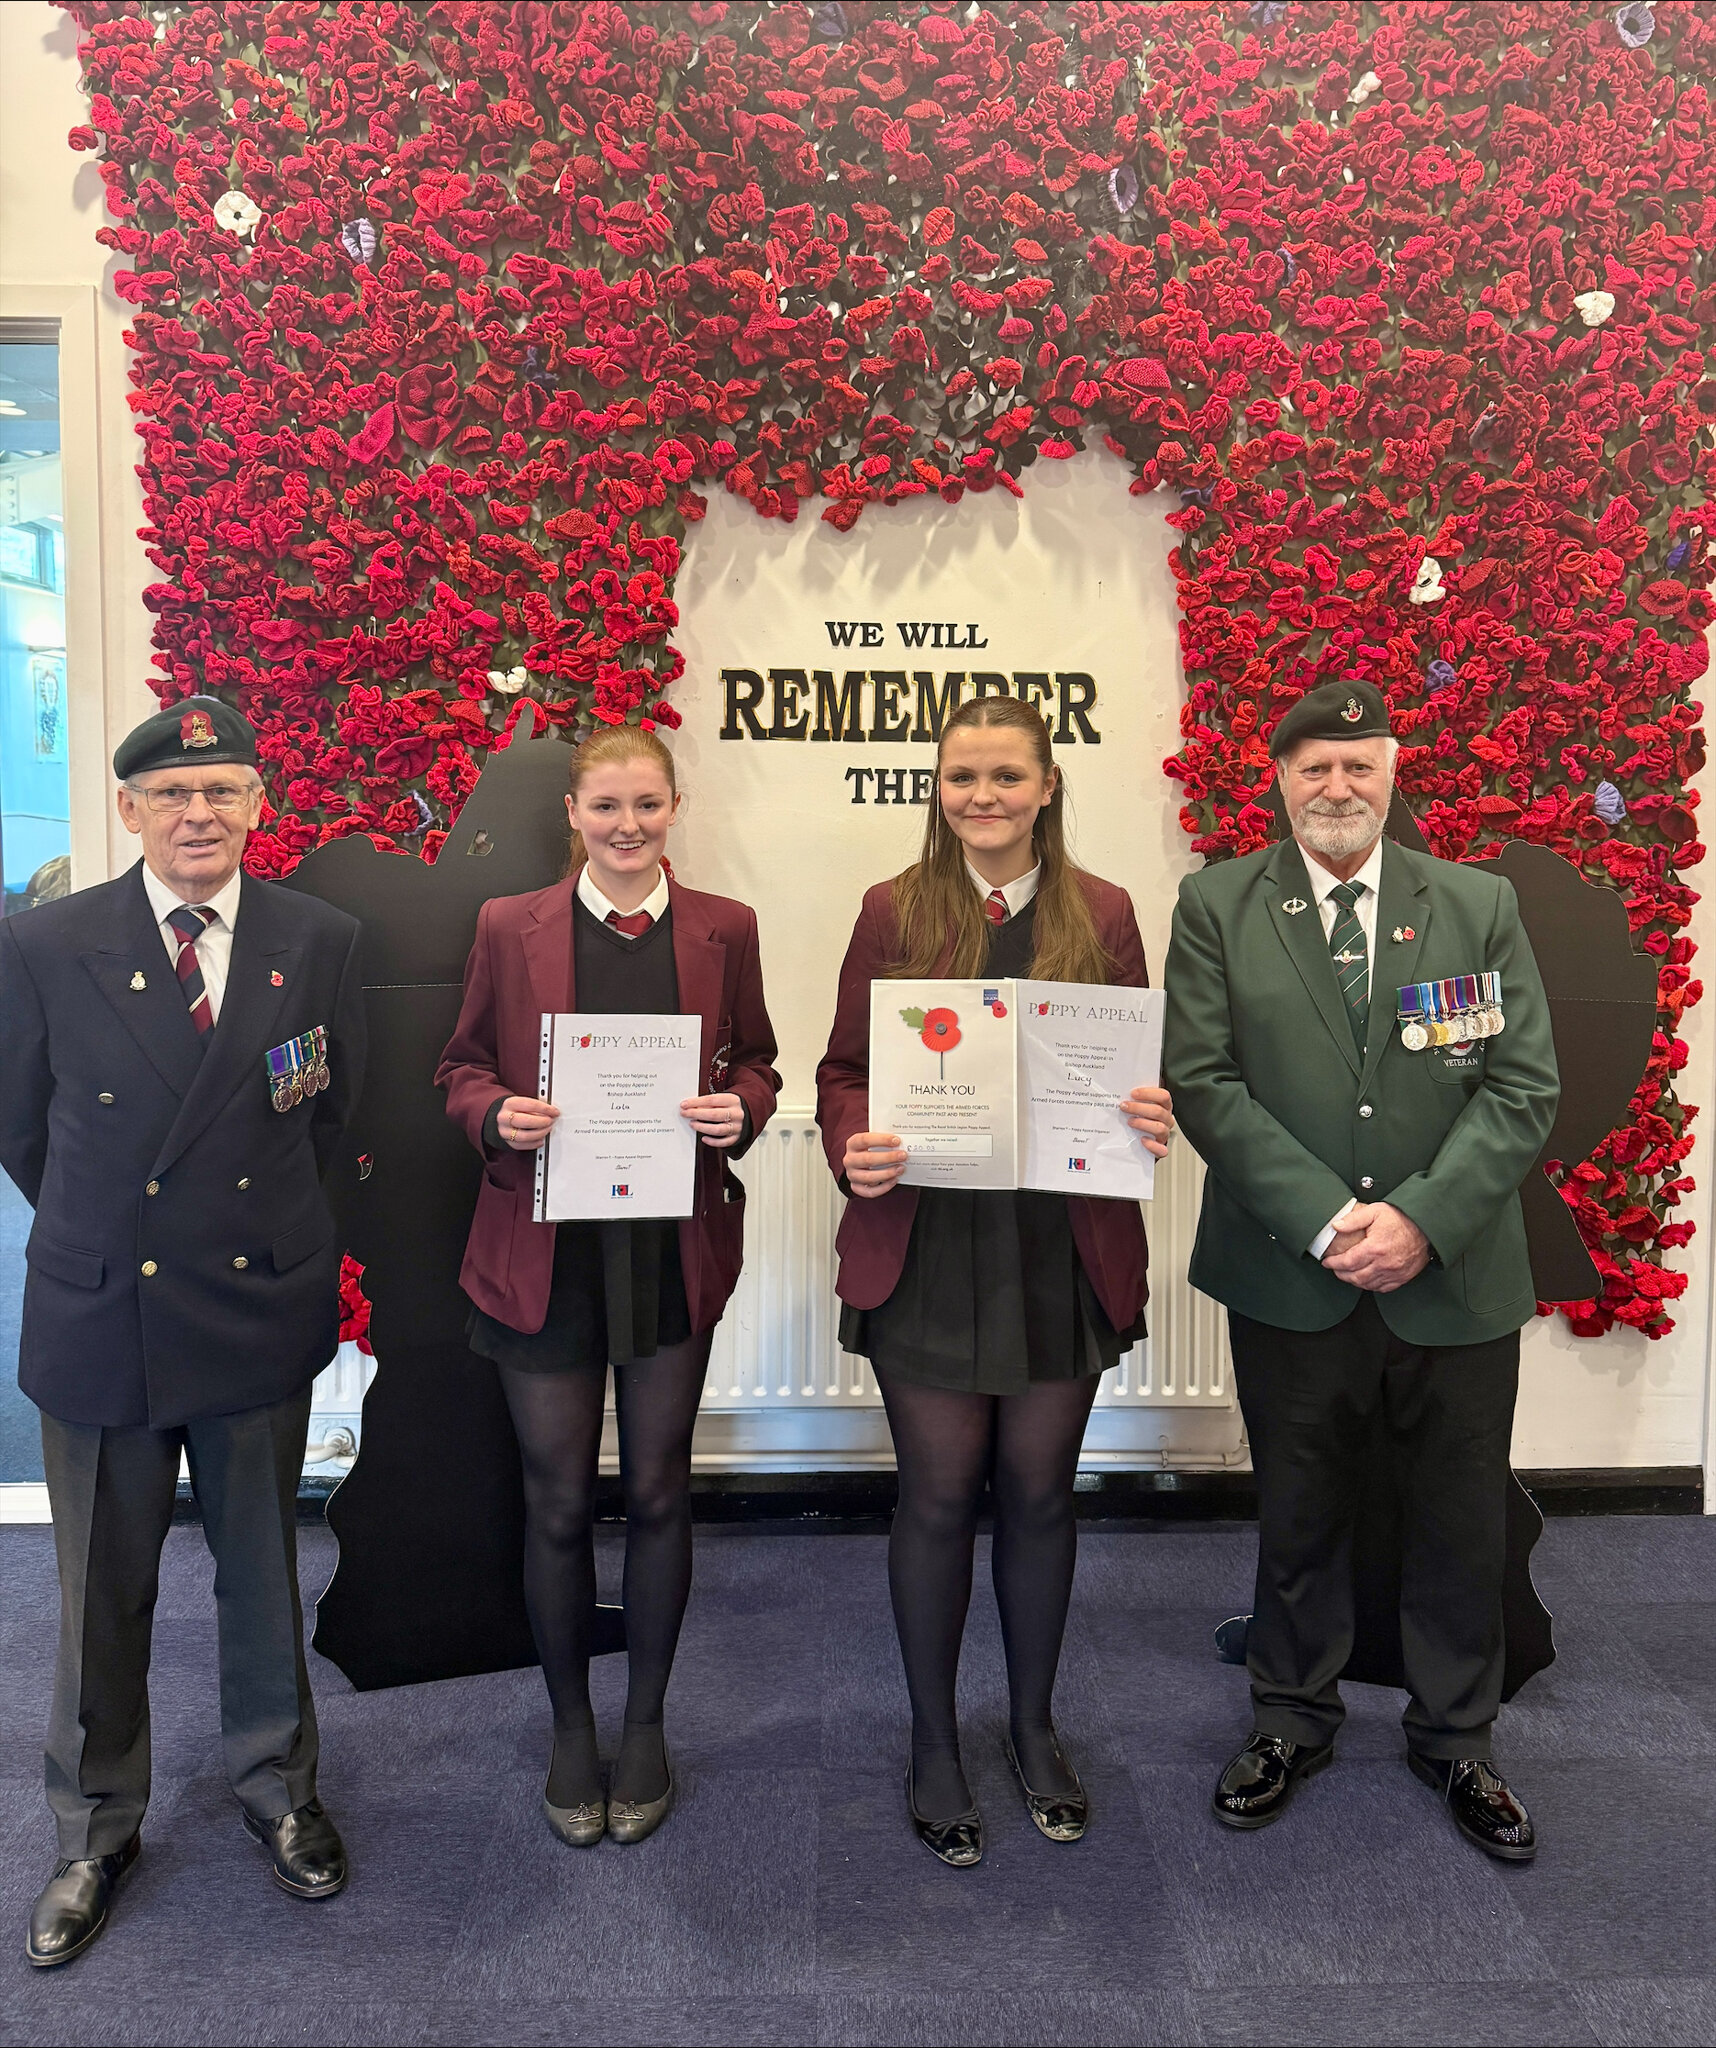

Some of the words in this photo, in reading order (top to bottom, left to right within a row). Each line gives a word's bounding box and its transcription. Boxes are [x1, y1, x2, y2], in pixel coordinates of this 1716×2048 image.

[825, 621, 884, 647] WE
[897, 622, 989, 649] WILL
[845, 767, 936, 804] THE
[1086, 1007, 1148, 1023] APPEAL
[627, 1036, 687, 1049] APPEAL
[1082, 1062, 1105, 1070] Auckland
[1443, 1057, 1478, 1067] VETERAN
[1067, 1072, 1092, 1087] Lucy
[909, 1084, 948, 1096] THANK
[951, 1085, 976, 1096] YOU
